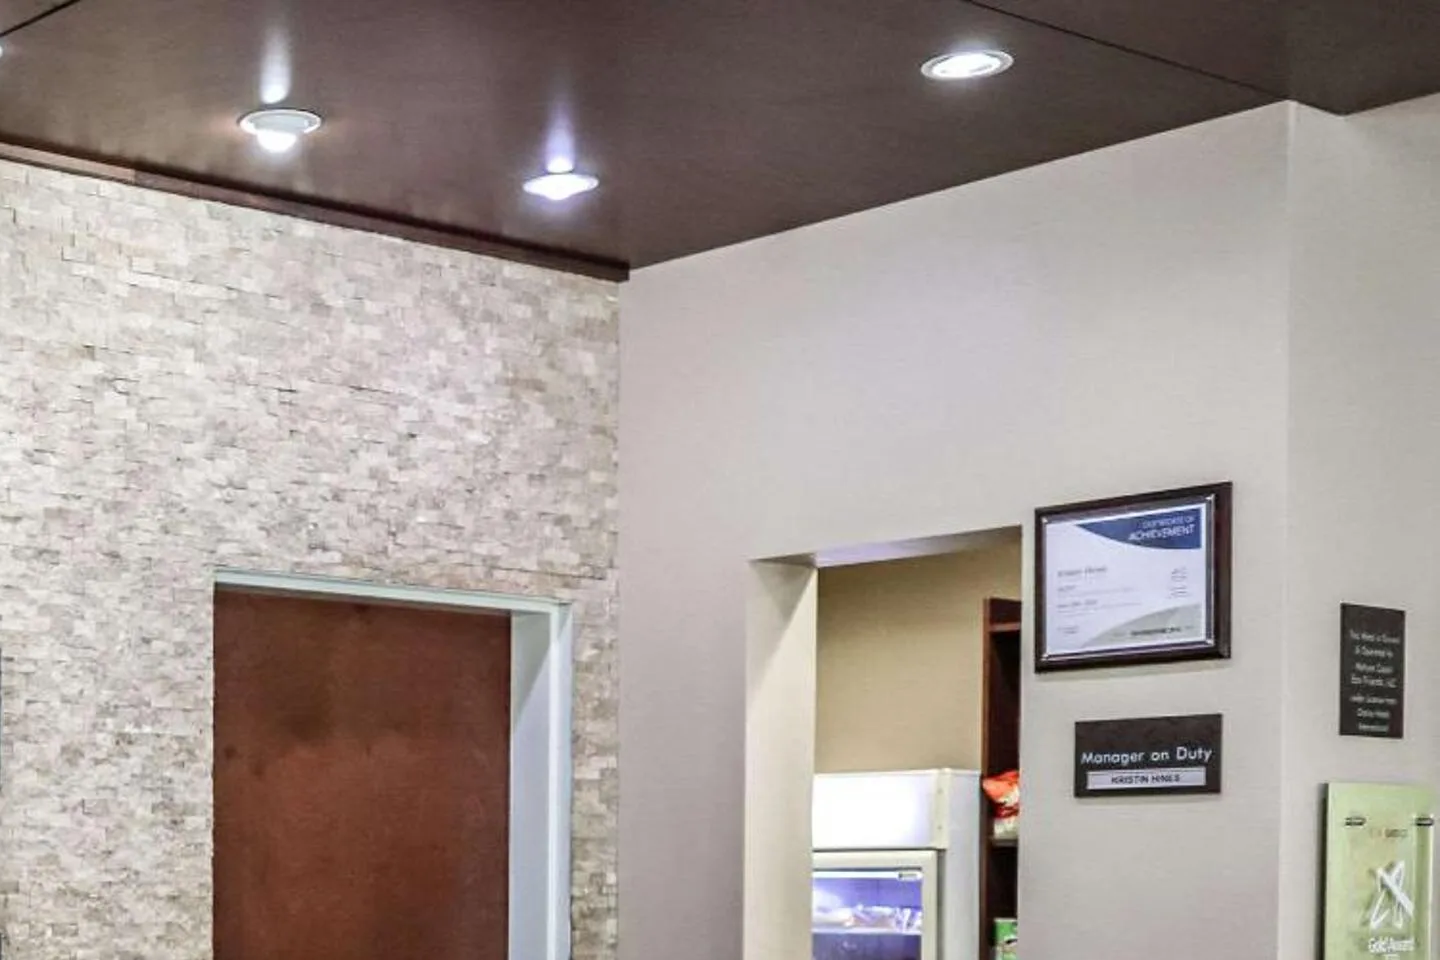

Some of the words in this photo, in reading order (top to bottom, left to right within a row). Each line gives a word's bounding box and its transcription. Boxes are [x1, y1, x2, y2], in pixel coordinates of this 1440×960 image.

[1128, 524, 1196, 541] ACHIEVEMENT
[1081, 752, 1145, 766] Manager
[1151, 752, 1170, 761] on
[1176, 746, 1213, 763] Duty
